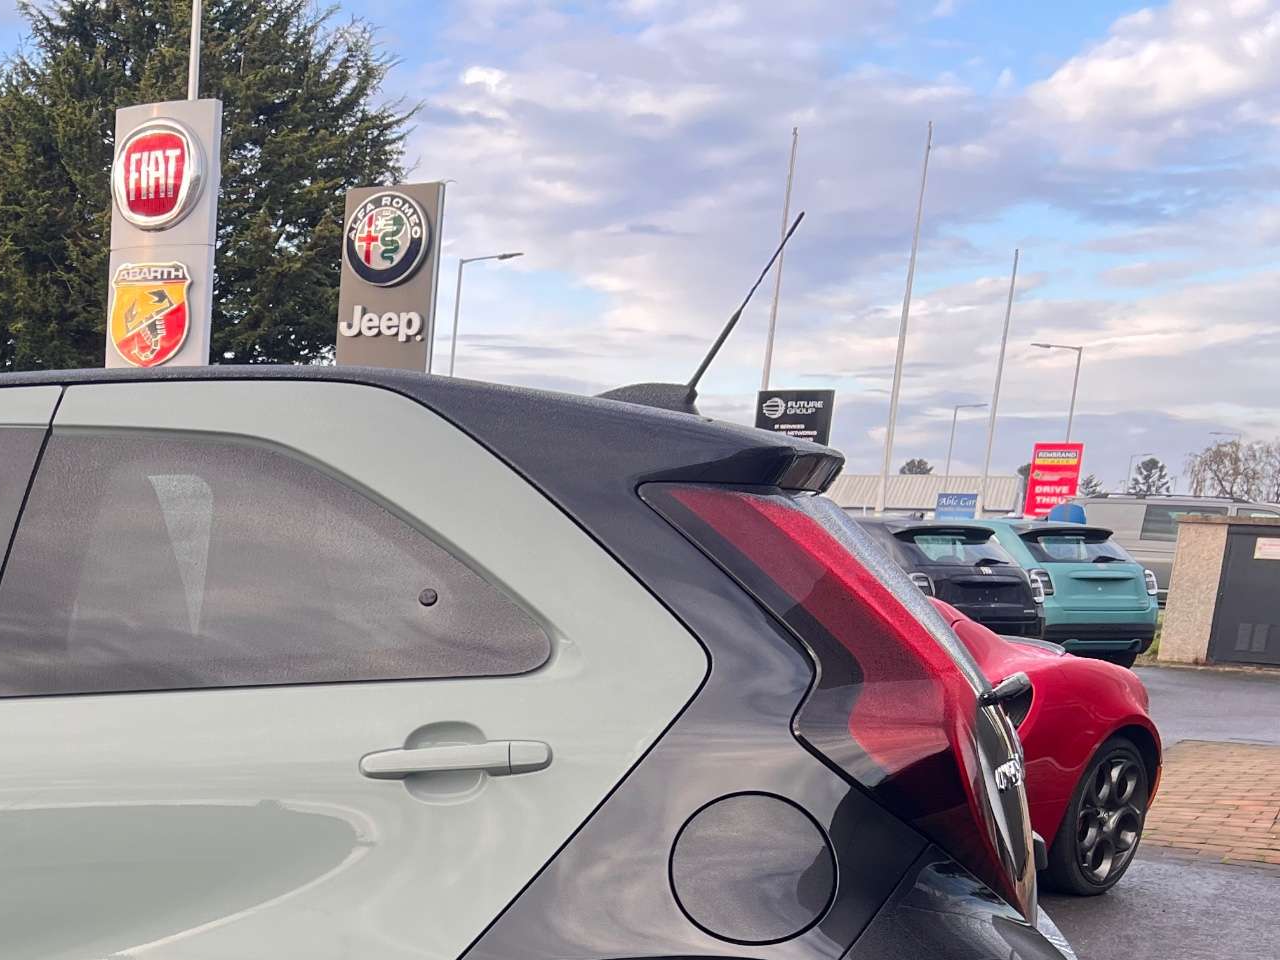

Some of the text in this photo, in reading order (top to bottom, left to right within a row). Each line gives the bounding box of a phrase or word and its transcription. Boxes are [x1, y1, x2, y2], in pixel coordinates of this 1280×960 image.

[129, 148, 181, 201] FIAT
[348, 197, 421, 240] ALFA ROMEO
[119, 267, 184, 281] ABARTH
[339, 305, 422, 342] Jeep
[787, 400, 824, 408] FUTURE
[1034, 485, 1069, 494] DRIVE
[1035, 496, 1066, 505] THRU
